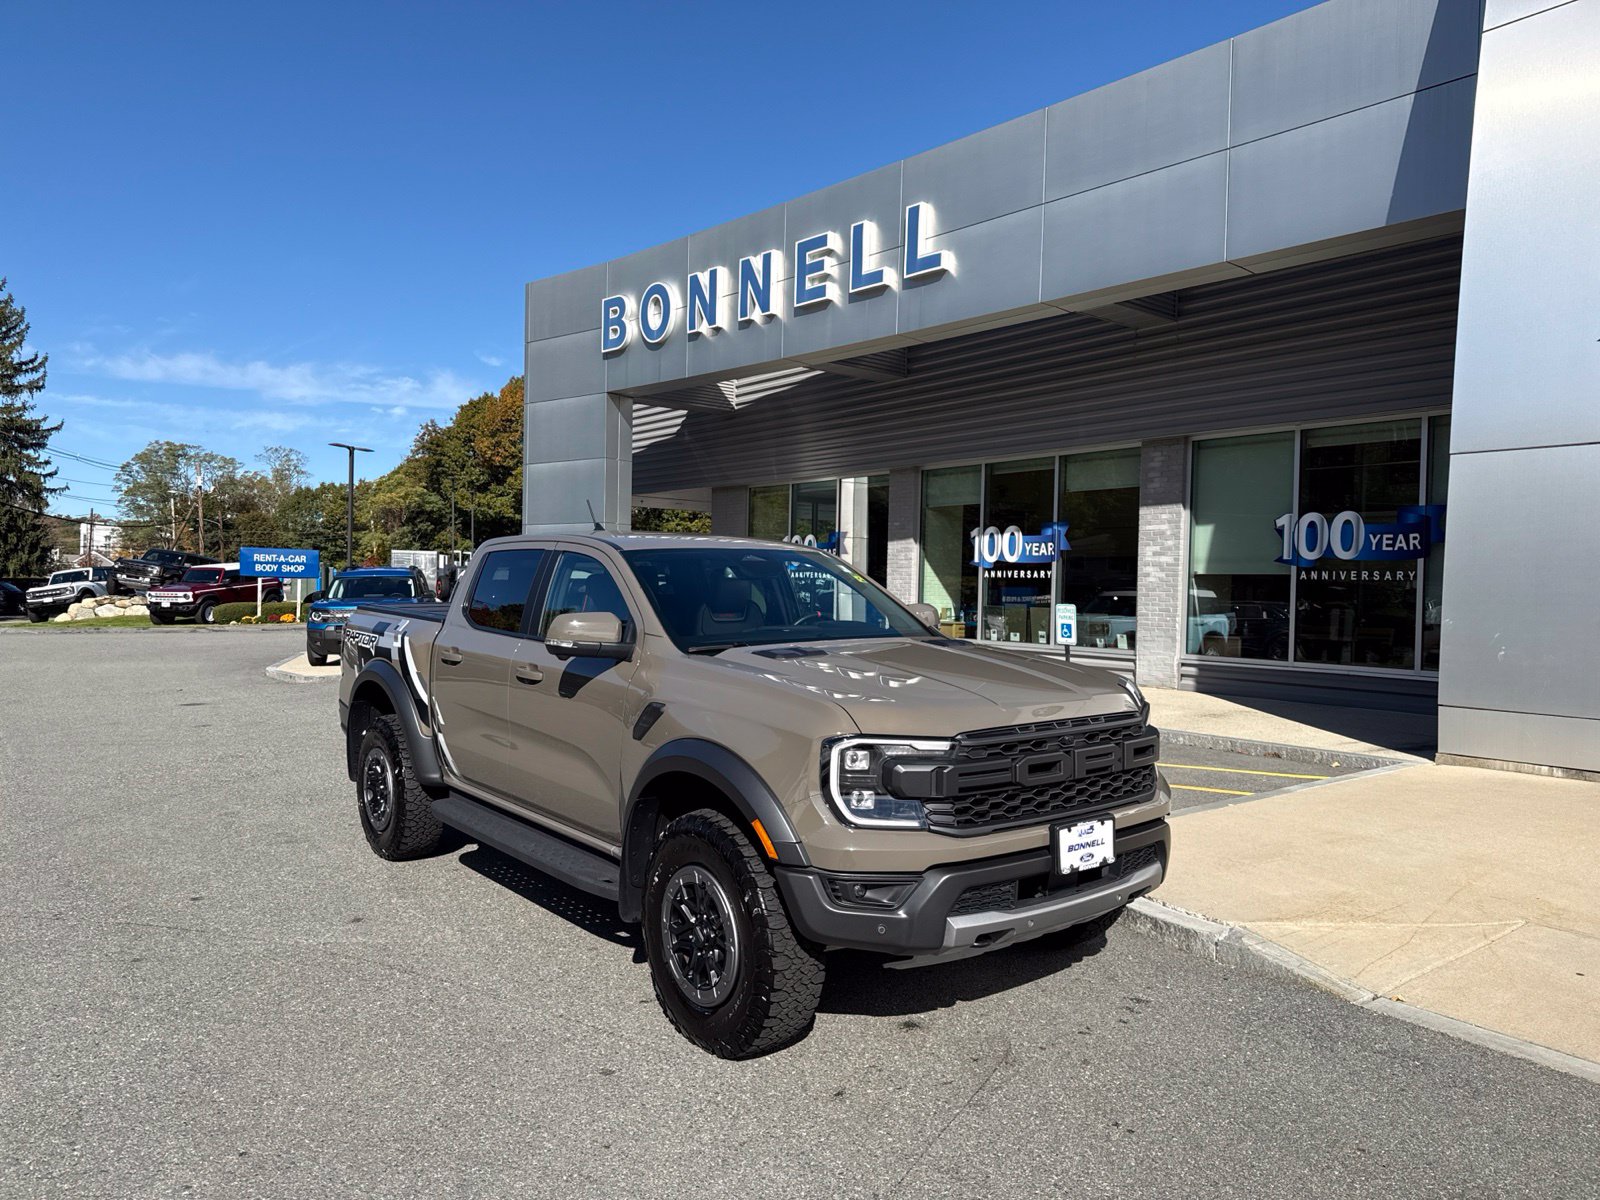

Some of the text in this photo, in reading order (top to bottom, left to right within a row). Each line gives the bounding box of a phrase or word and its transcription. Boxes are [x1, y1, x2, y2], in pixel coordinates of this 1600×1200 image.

[602, 201, 950, 352] BONNELL
[1275, 511, 1421, 560] 100 YEAR
[970, 525, 1055, 563] 100 YEAR
[254, 553, 306, 563] RENT-A-CAR
[255, 564, 305, 573] BODY SHOP
[790, 571, 835, 579] ANNIVERSAR
[984, 570, 1052, 579] ANNIVERSARY
[1300, 570, 1416, 581] ANNIVERSARY
[345, 629, 378, 655] RAPTOR
[944, 734, 1160, 797] FORD
[1067, 838, 1105, 853] BONNELL
